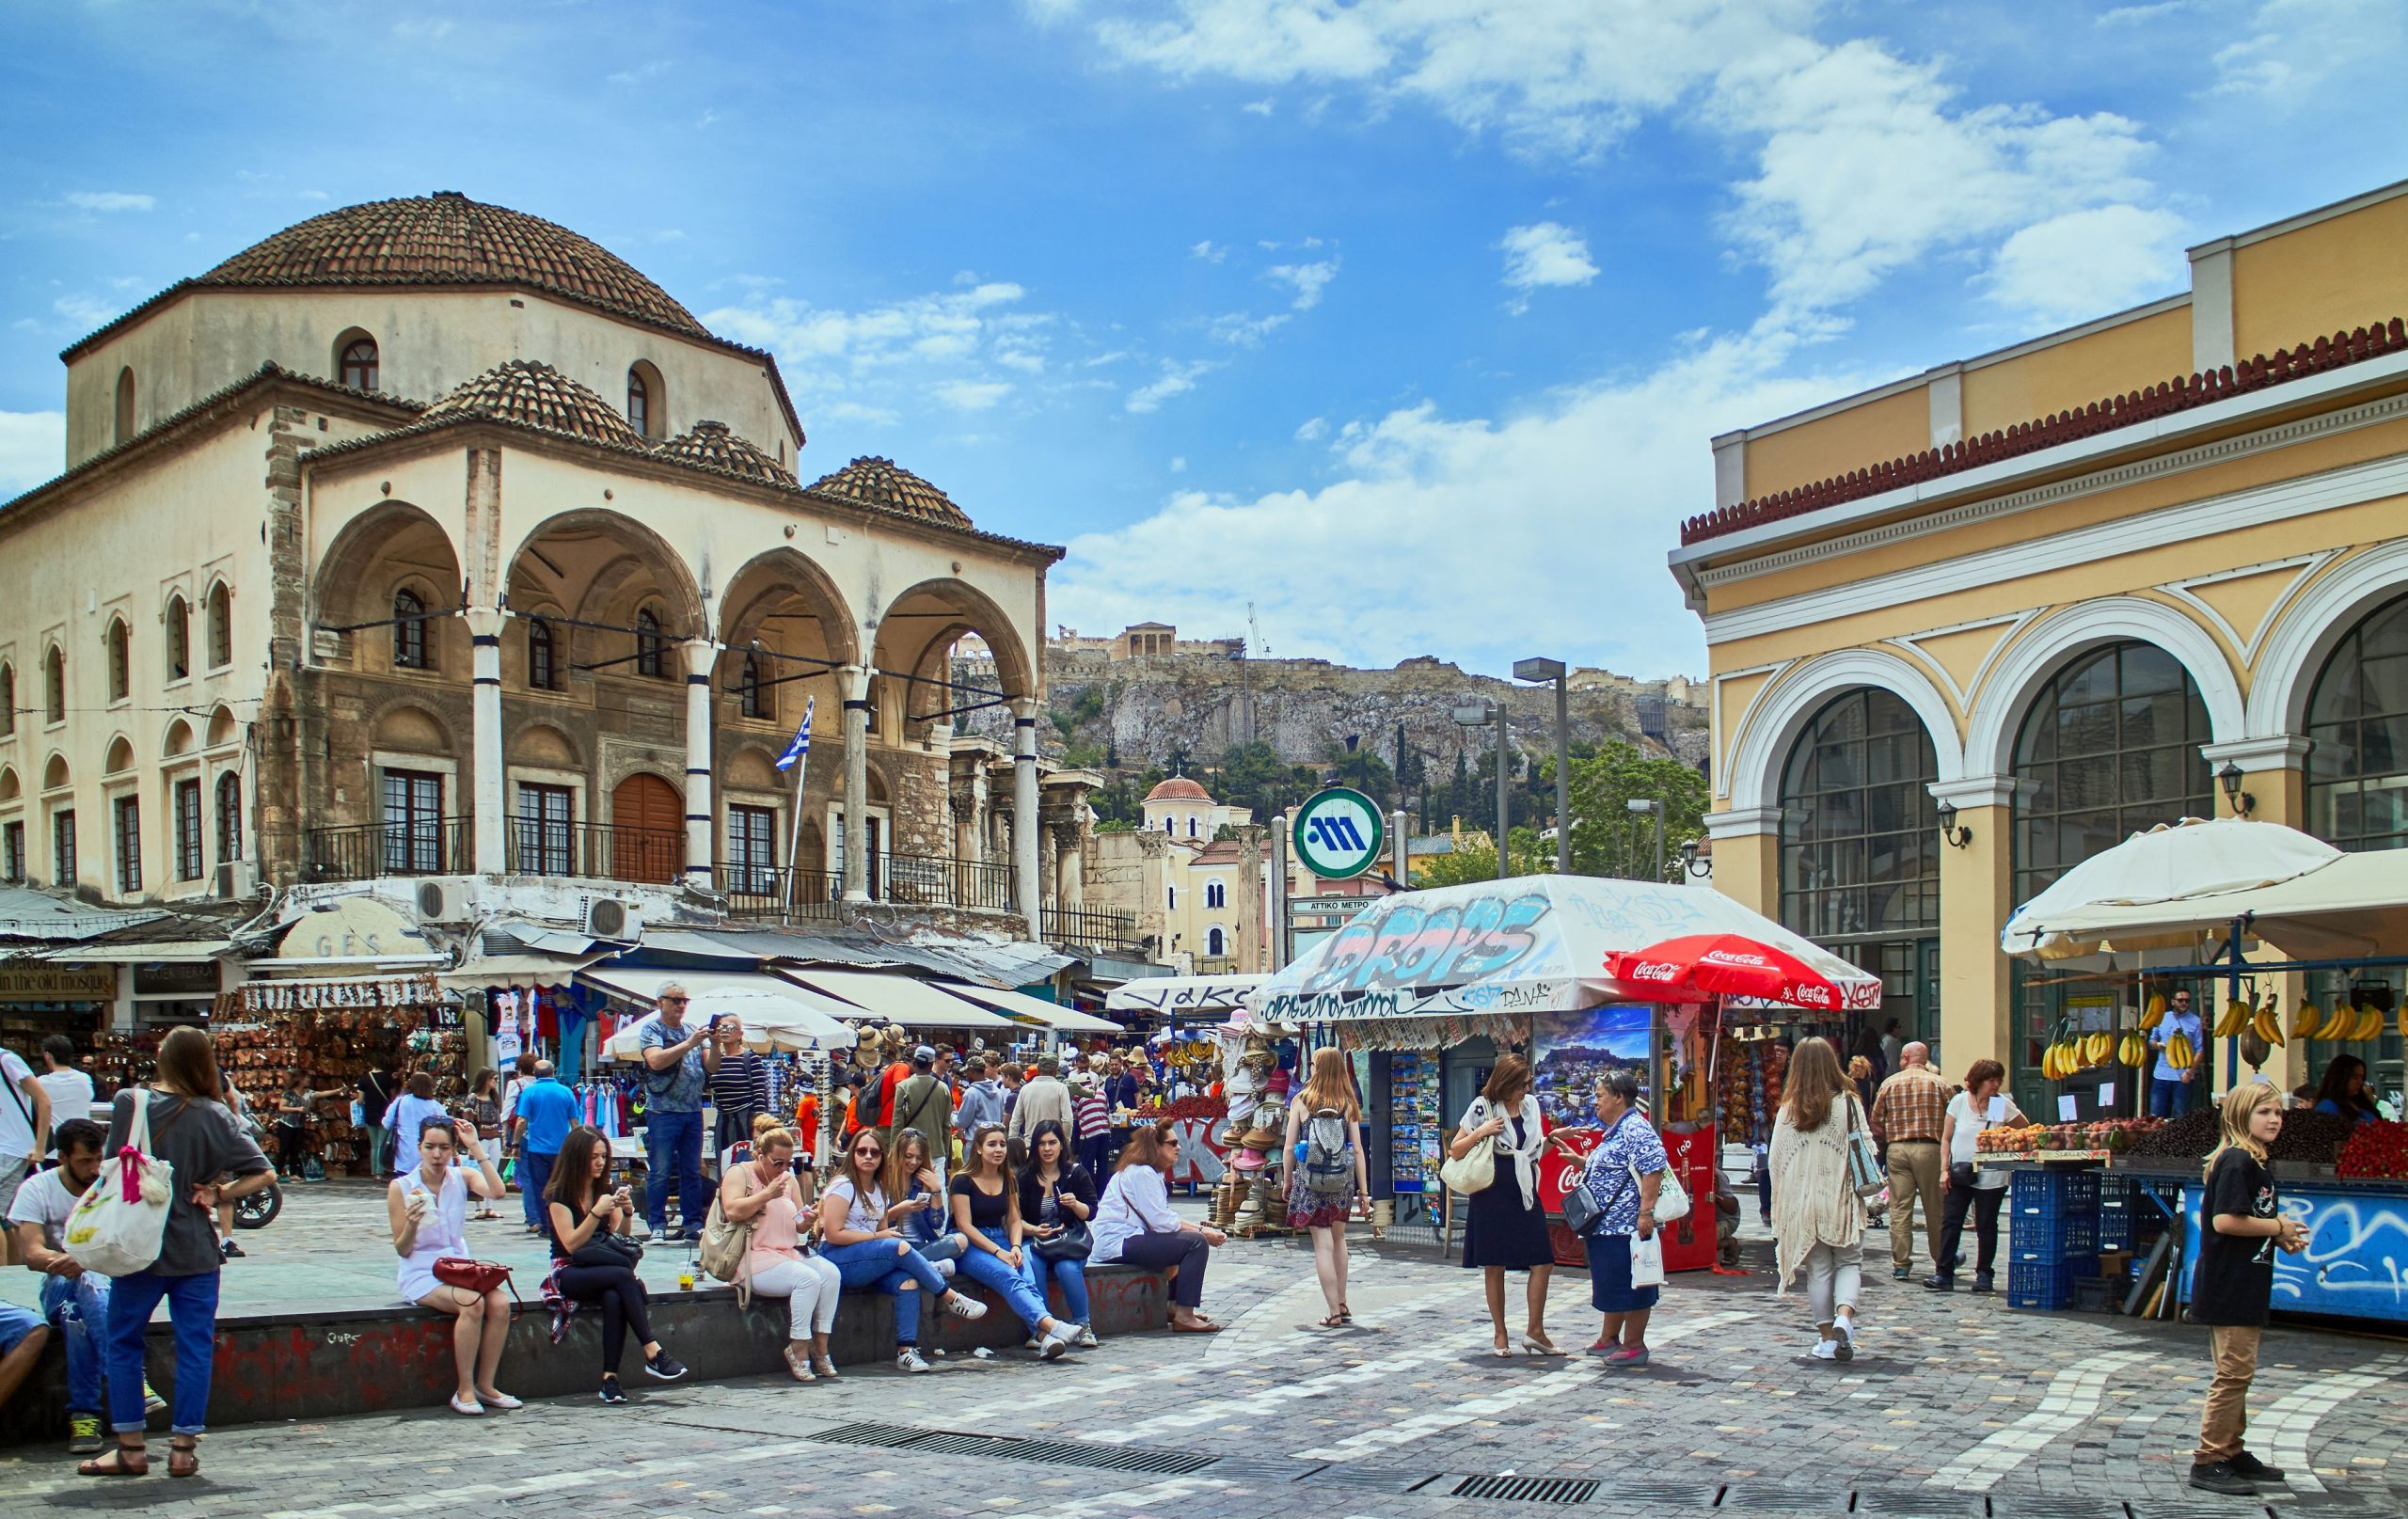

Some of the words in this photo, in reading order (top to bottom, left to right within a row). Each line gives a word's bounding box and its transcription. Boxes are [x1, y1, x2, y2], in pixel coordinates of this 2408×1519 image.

[1310, 902, 1339, 910] ΑΤΤΙΚΟ
[1341, 901, 1370, 910] ΜΕΤΡΟ
[1307, 894, 1552, 993] DROPS
[180, 965, 214, 979] TERRA
[14, 973, 36, 990] the
[38, 973, 58, 990] old
